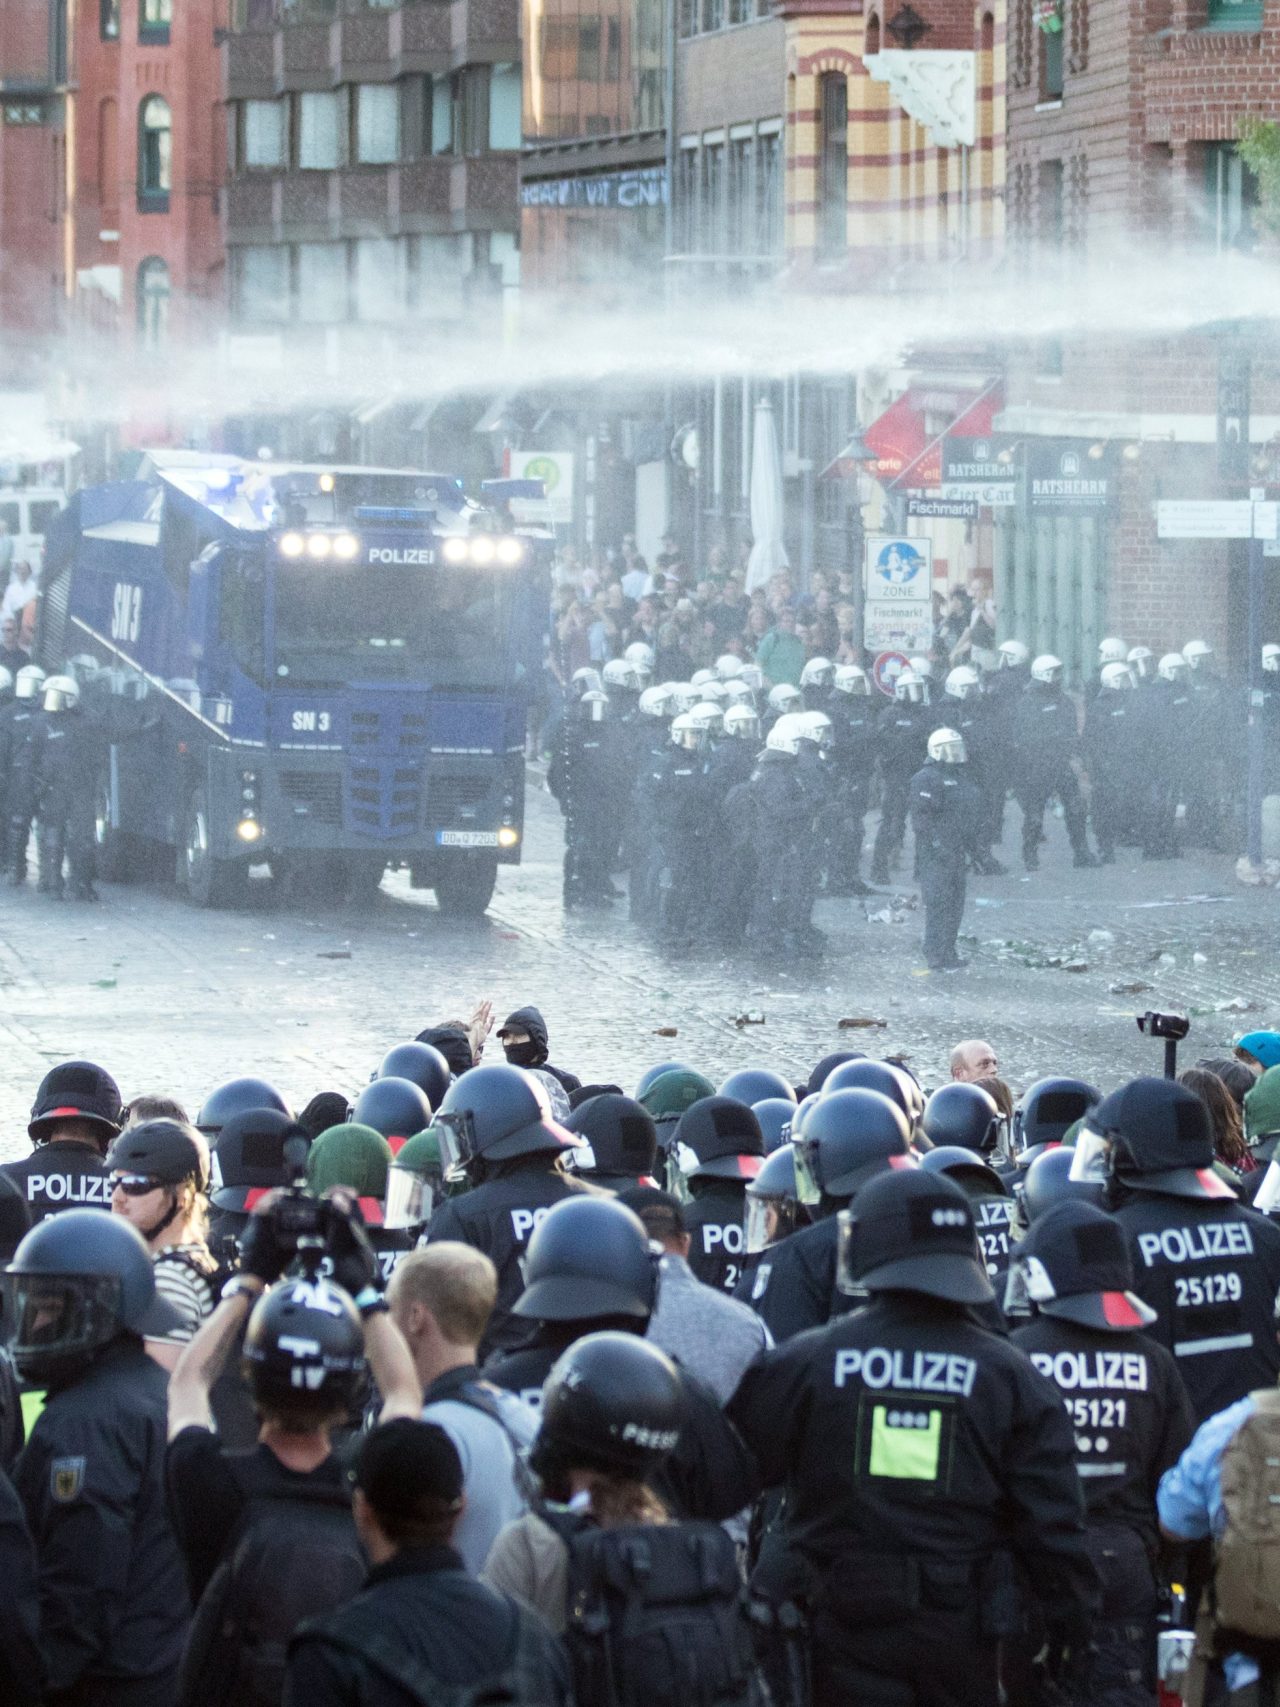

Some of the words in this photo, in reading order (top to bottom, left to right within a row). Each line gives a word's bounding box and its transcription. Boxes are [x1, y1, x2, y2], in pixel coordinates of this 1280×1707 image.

[1032, 480, 1107, 495] RATSHERRN
[908, 501, 975, 516] Fischmarkt
[368, 549, 435, 564] POLIZEI
[882, 586, 915, 598] ZONE
[874, 606, 923, 618] Fischmarkt
[292, 711, 316, 731] SN
[318, 712, 331, 731] 3
[1137, 1221, 1254, 1267] POLIZEI
[1174, 1272, 1242, 1307] 25129
[834, 1347, 978, 1398] POLIZEI
[1029, 1352, 1149, 1392] POLIZEI
[1063, 1398, 1127, 1428] 5121
